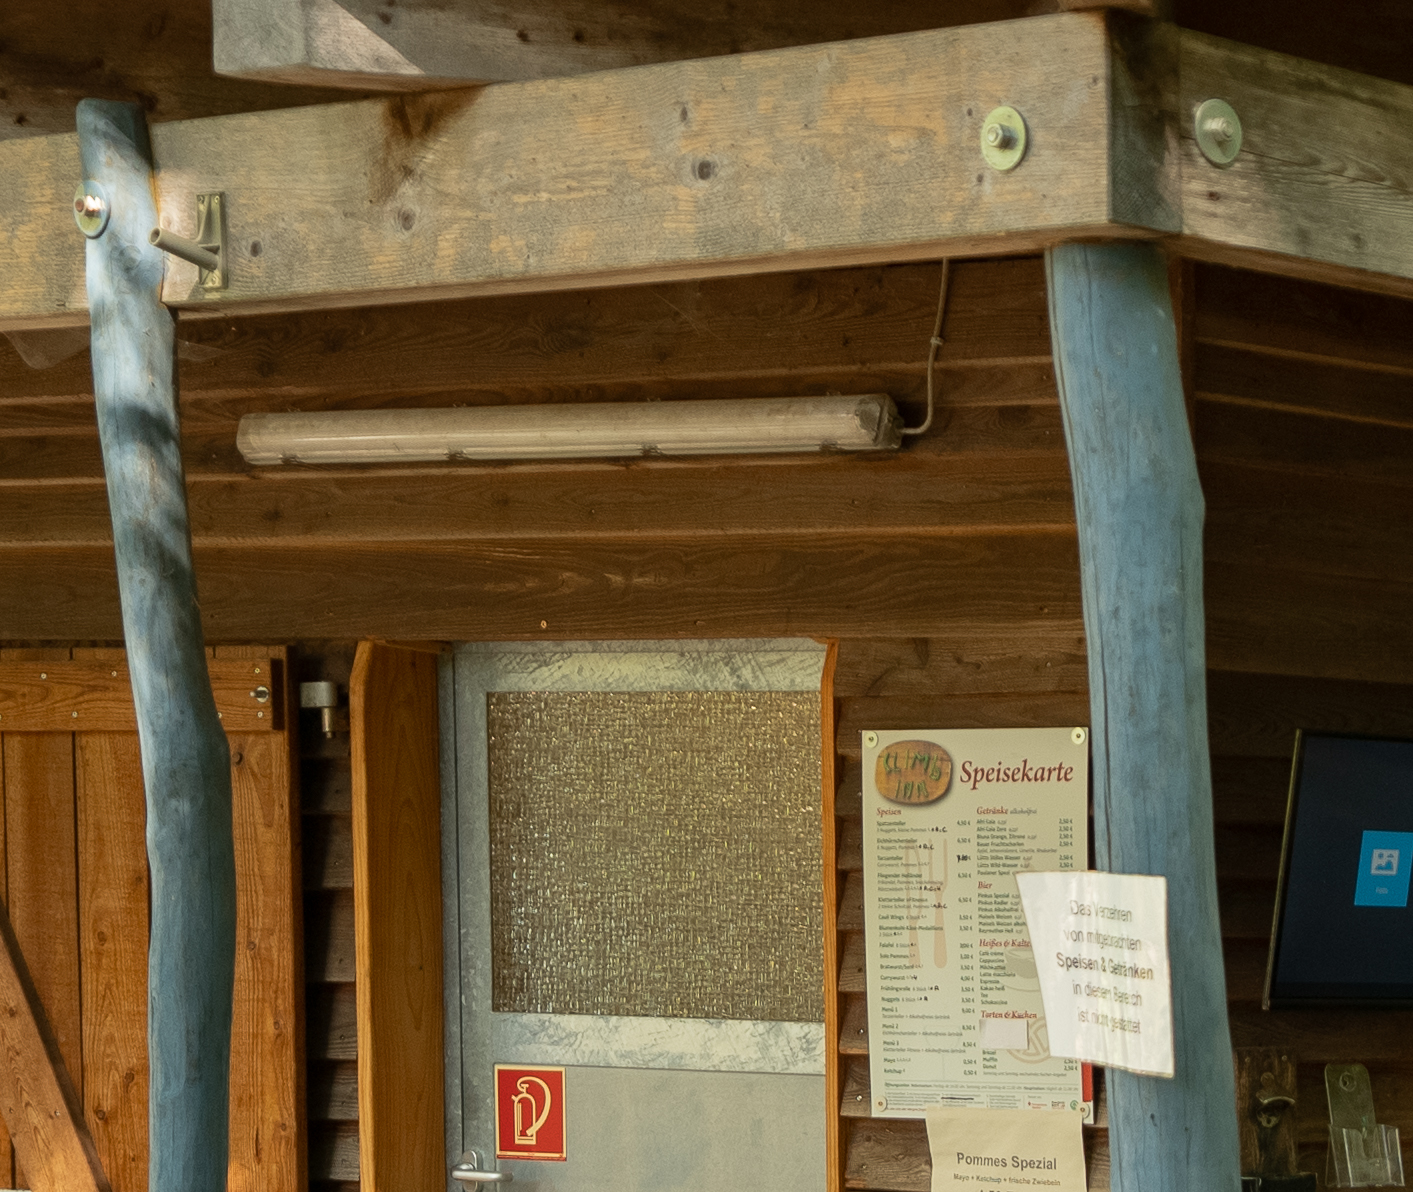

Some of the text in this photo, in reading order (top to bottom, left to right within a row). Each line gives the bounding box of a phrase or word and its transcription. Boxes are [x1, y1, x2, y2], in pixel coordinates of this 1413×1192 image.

[960, 758, 1074, 791] Speisekarte
[877, 807, 902, 818] Speisen
[977, 806, 1008, 815] Getränke
[978, 880, 993, 889] Bier
[1070, 900, 1091, 916] Das
[1064, 929, 1083, 943] von
[979, 939, 1002, 949] Heißes
[1056, 952, 1154, 981] Speisen & Getränken
[1072, 979, 1082, 995] in
[981, 1010, 1003, 1019] Torten
[1011, 1010, 1037, 1019] Kuchen
[1077, 1007, 1089, 1023] ist
[957, 1152, 1057, 1172] Pommes Spezial
[953, 1173, 970, 1182] Mayo
[975, 1175, 1002, 1184] Ketchup
[1008, 1177, 1031, 1185] frische
[1032, 1177, 1061, 1186] Zwiebeln
